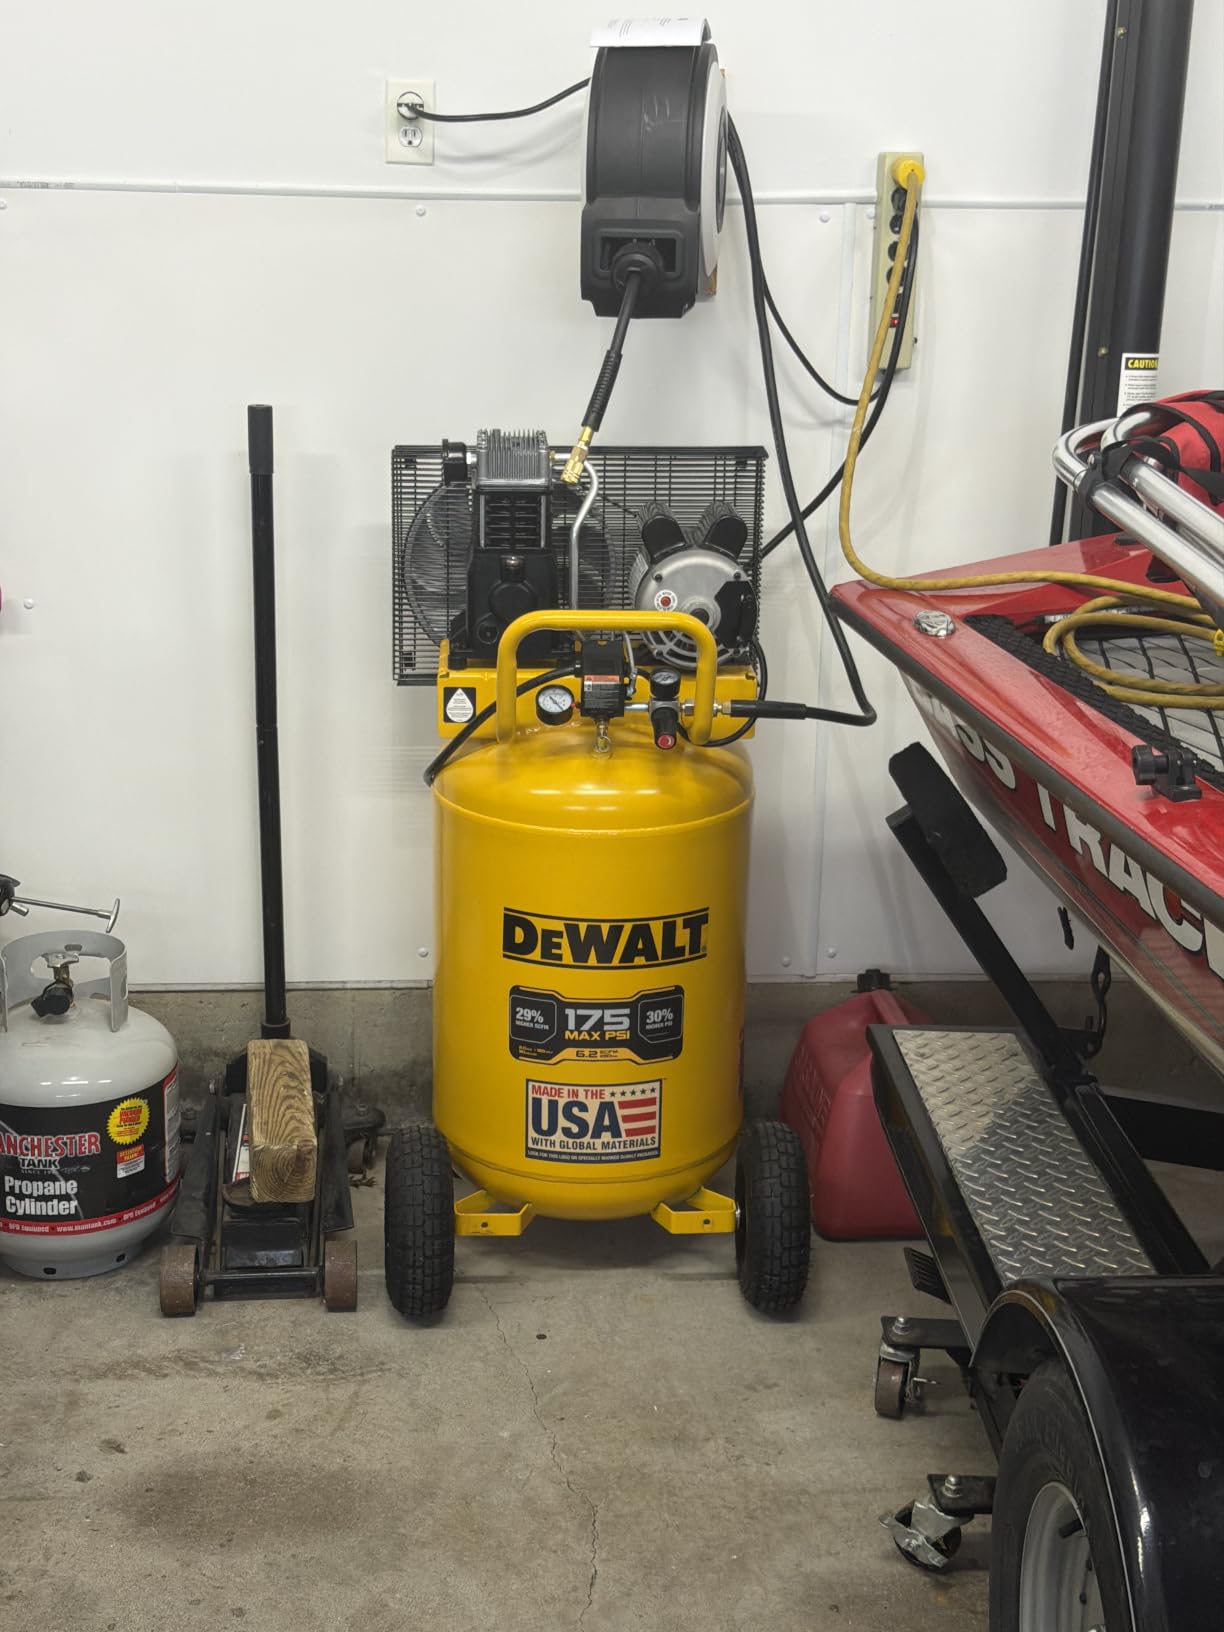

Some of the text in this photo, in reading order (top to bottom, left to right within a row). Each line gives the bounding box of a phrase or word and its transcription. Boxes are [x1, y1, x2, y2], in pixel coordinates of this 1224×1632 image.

[502, 912, 709, 965] DEWALT
[515, 1007, 544, 1024] 29%
[565, 1008, 631, 1031] 175
[646, 1007, 674, 1024] 30%
[564, 1030, 630, 1040] MAX PSI
[576, 1050, 598, 1058] 6.2
[531, 1084, 606, 1100] MADE IN THE
[531, 1097, 623, 1140] USA
[531, 1136, 656, 1151] WITH GLOBAL MATERIALS
[19, 1157, 60, 1170] TANK
[4, 1175, 78, 1197] Propane
[5, 1195, 78, 1216] Cylinder
